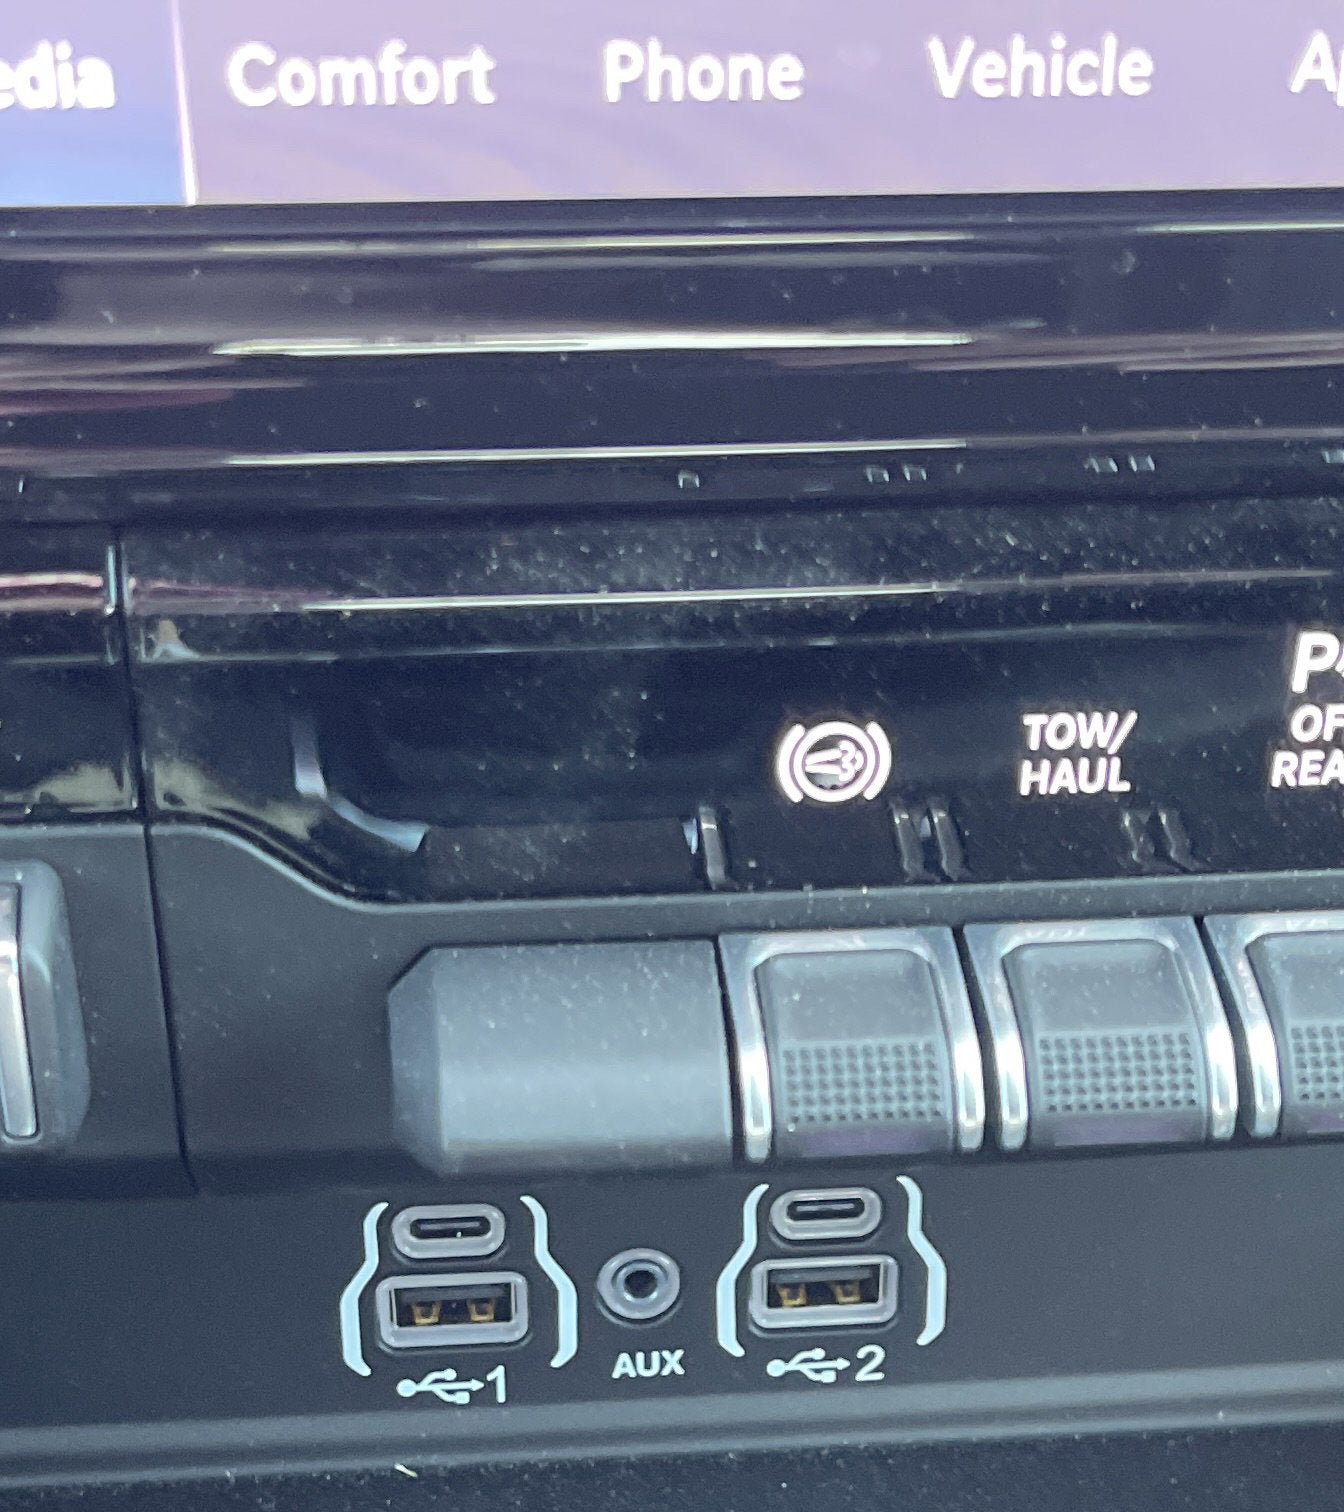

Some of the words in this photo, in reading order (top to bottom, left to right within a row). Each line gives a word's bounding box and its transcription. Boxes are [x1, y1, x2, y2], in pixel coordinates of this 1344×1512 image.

[226, 40, 496, 107] Comfort
[604, 38, 805, 103] Phone
[927, 34, 1154, 98] Vehicle
[1022, 710, 1138, 753] TOW/
[1020, 757, 1131, 796] HAUL
[611, 1349, 686, 1379] AUX
[854, 1344, 886, 1382] 2
[486, 1364, 507, 1404] 1
